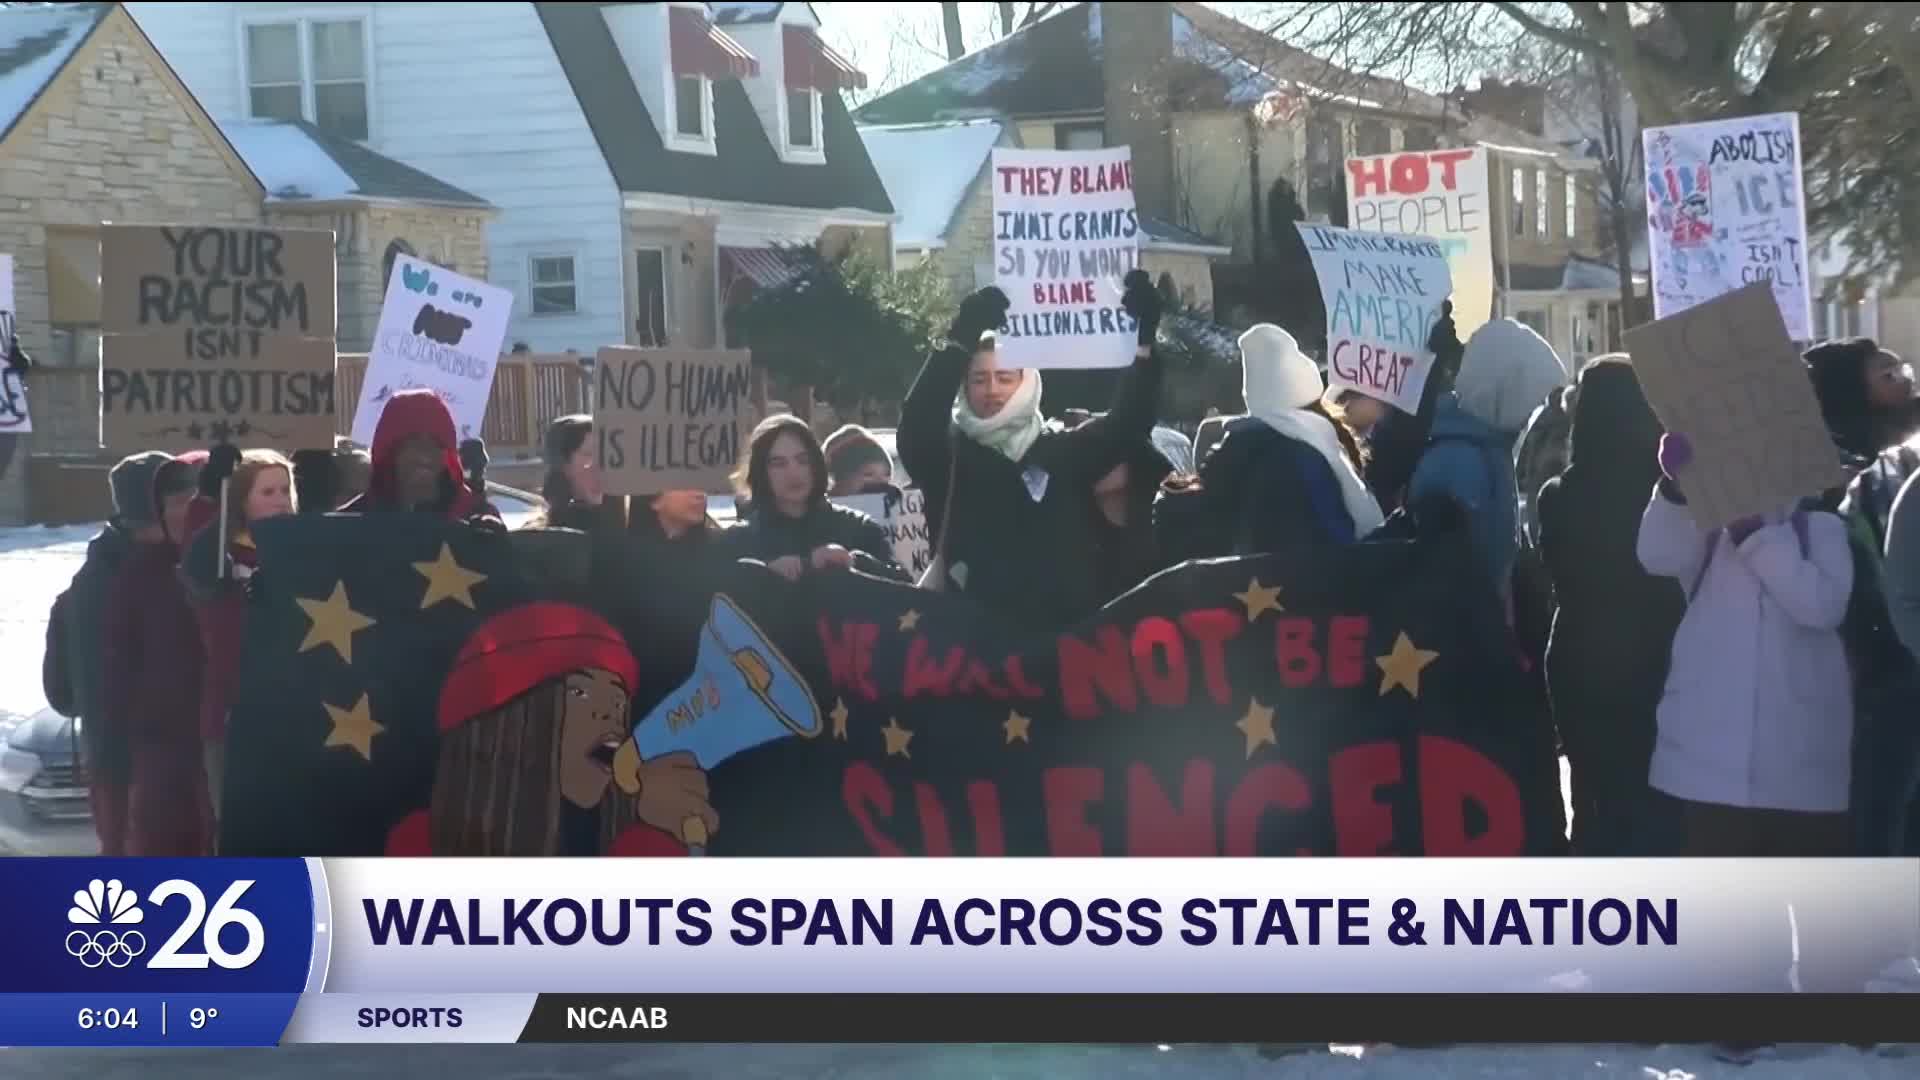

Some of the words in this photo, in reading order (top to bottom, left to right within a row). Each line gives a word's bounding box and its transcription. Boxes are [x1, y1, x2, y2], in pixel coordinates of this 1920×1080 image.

[1710, 130, 1795, 165] ABOLISH
[996, 166, 1062, 196] THEY
[1348, 150, 1473, 197] HOT
[1734, 170, 1797, 217] ICE
[996, 208, 1138, 241] IMMIGRANTS
[1355, 192, 1481, 236] PEOPLE
[160, 227, 285, 281] YOUR
[998, 247, 1025, 278] SO
[1035, 247, 1071, 279] YOU
[1343, 258, 1428, 297] MAKE
[138, 275, 309, 331] RACISM
[1034, 280, 1097, 305] BLAME
[1331, 288, 1443, 348] AMERIC
[600, 359, 655, 411] NO
[665, 359, 752, 417] HUMAN
[1333, 340, 1414, 396] GREAT
[104, 369, 335, 416] PATRIOTISM
[600, 426, 625, 470] IS
[817, 610, 881, 702] WE
[1057, 607, 1243, 720] NOT
[1275, 616, 1371, 689] BE
